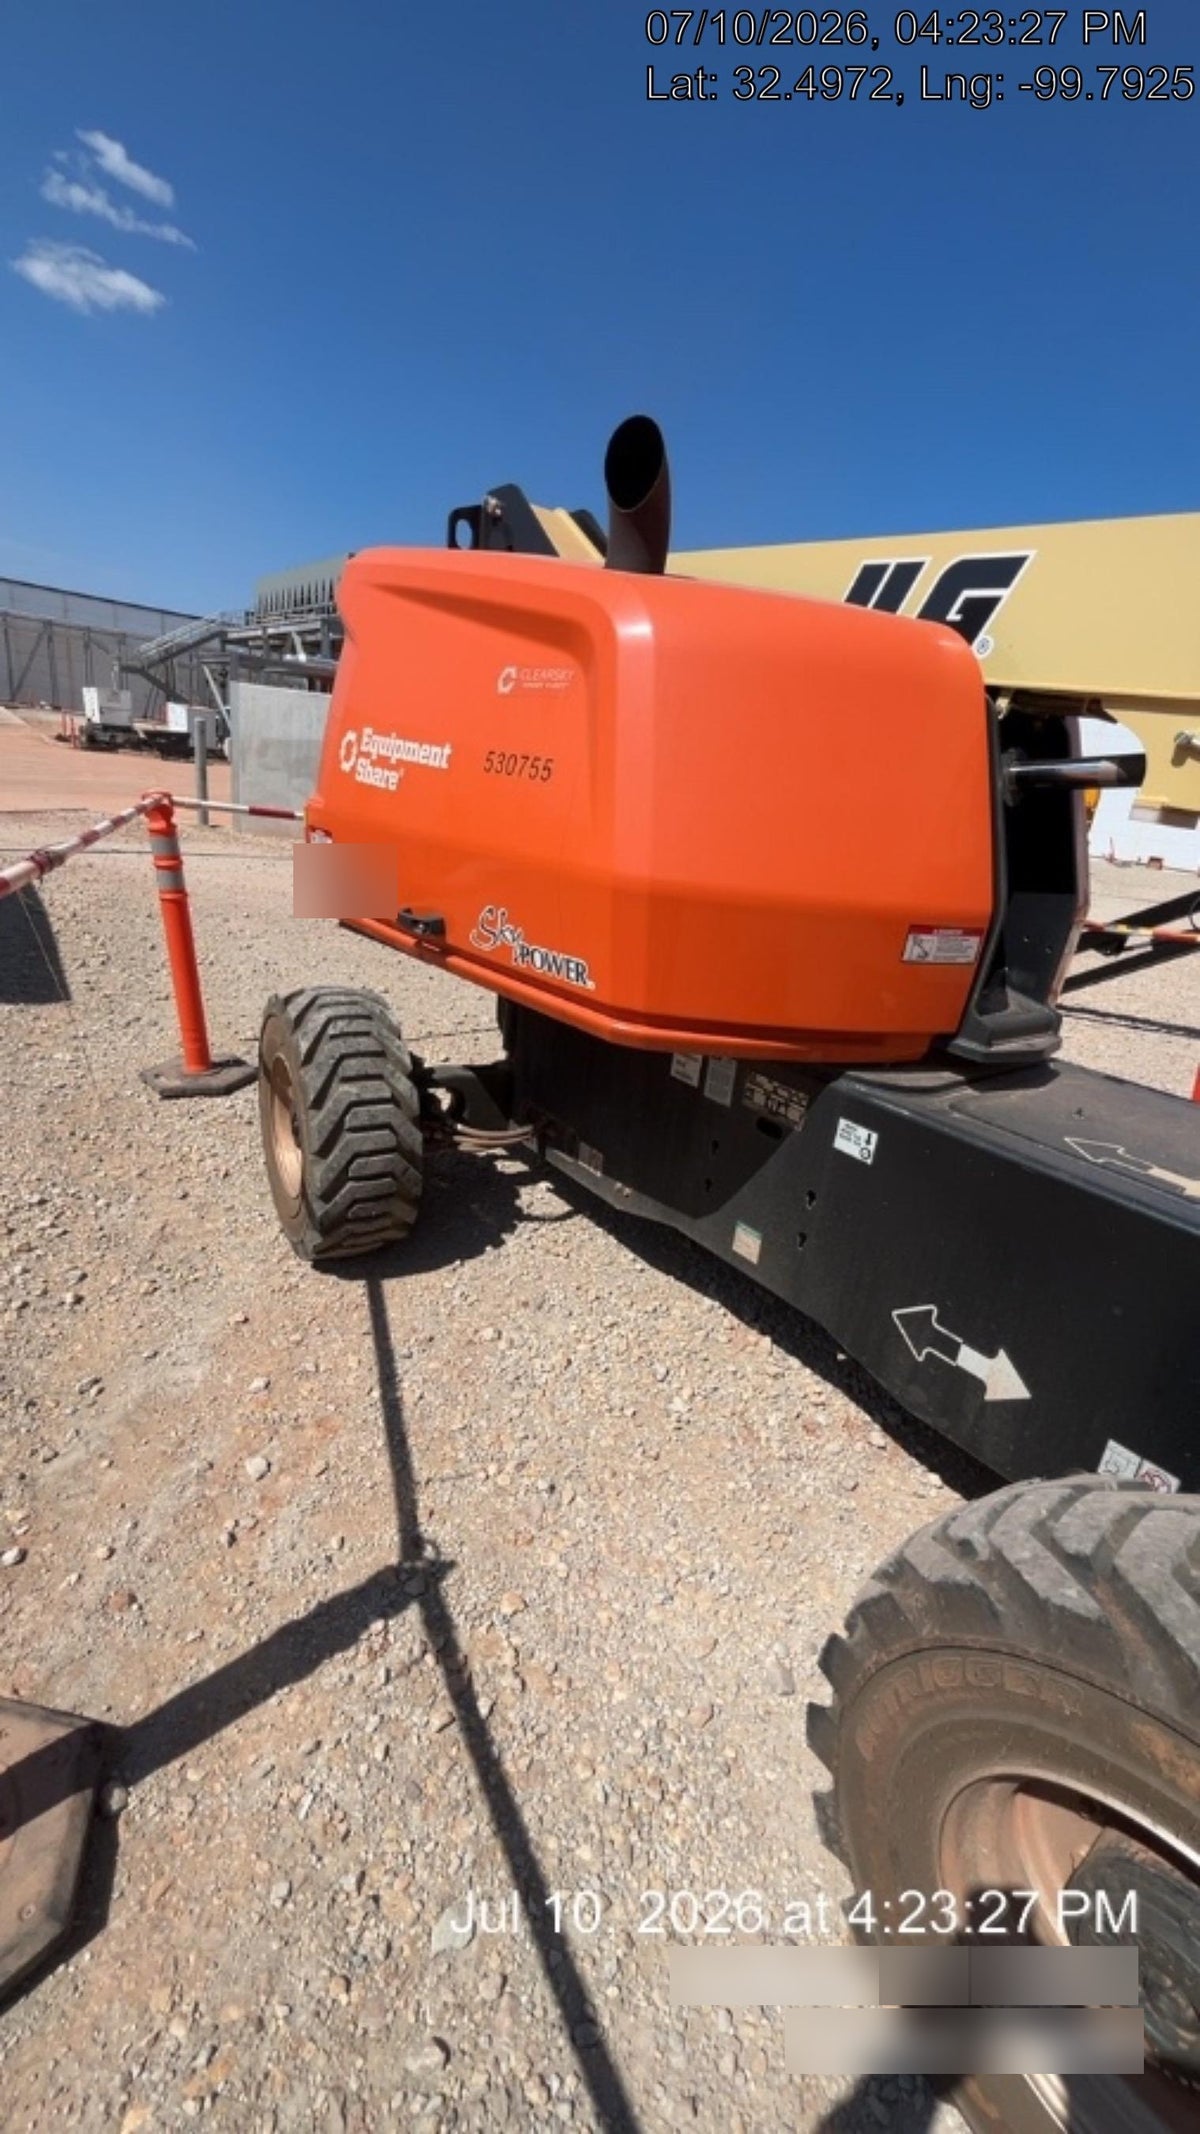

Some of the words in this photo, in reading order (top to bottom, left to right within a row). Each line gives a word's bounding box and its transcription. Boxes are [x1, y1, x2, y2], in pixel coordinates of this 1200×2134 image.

[360, 727, 452, 769] Equipment
[484, 750, 554, 783] 530755
[355, 757, 400, 791] Share
[518, 943, 588, 986] POWER
